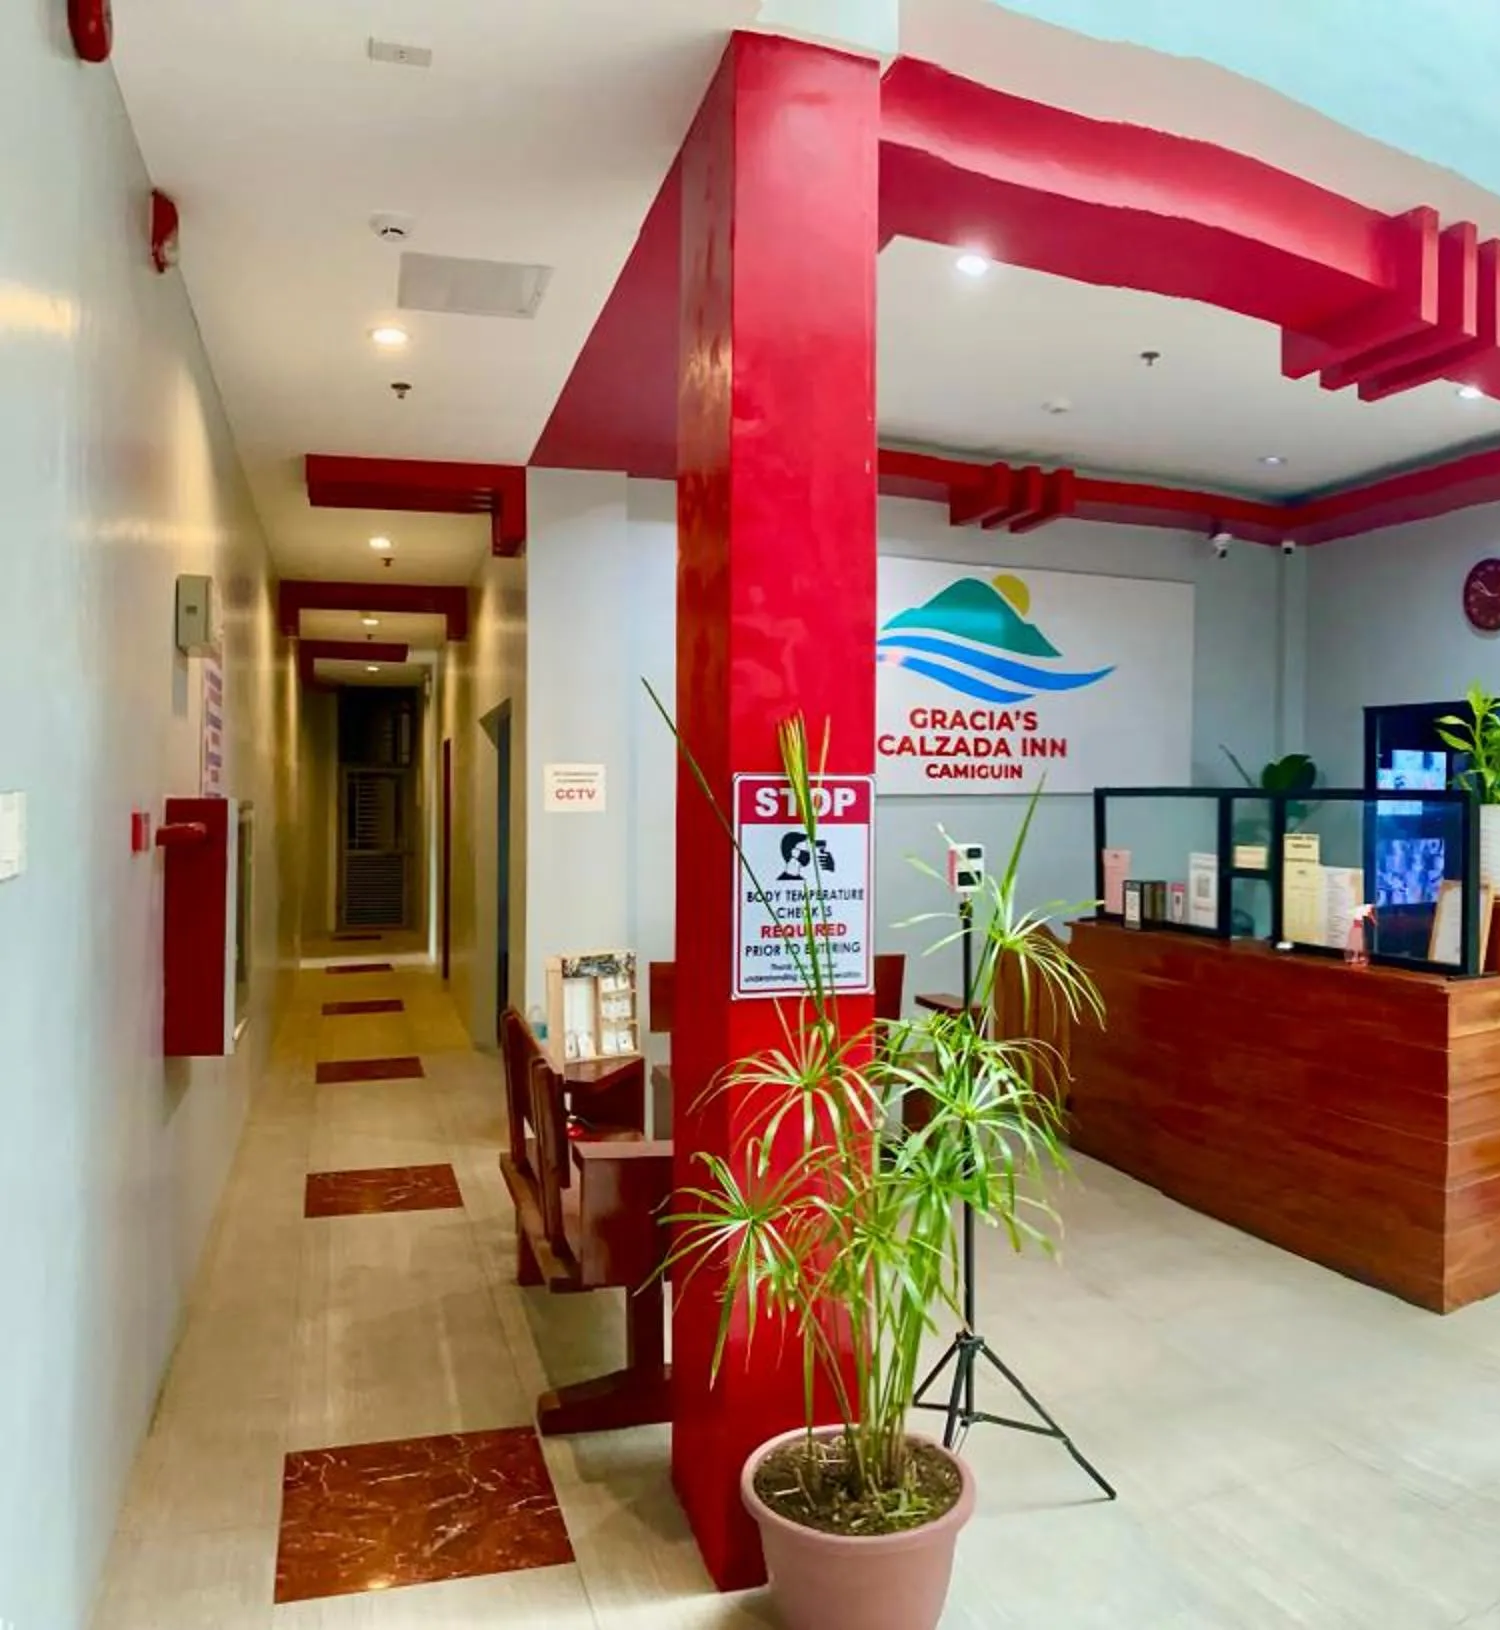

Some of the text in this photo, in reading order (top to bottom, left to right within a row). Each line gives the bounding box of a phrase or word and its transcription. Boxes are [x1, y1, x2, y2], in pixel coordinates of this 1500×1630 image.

[909, 708, 1038, 731] GRACIA'S
[877, 734, 1067, 758] CALZADA INN
[925, 763, 1023, 779] CAMIGUIN
[555, 788, 597, 801] CCTV
[755, 787, 857, 817] STOP
[746, 891, 780, 902] BODY
[776, 906, 819, 919] CHEK
[760, 923, 848, 938] REQURED
[745, 944, 781, 957] PRIOR
